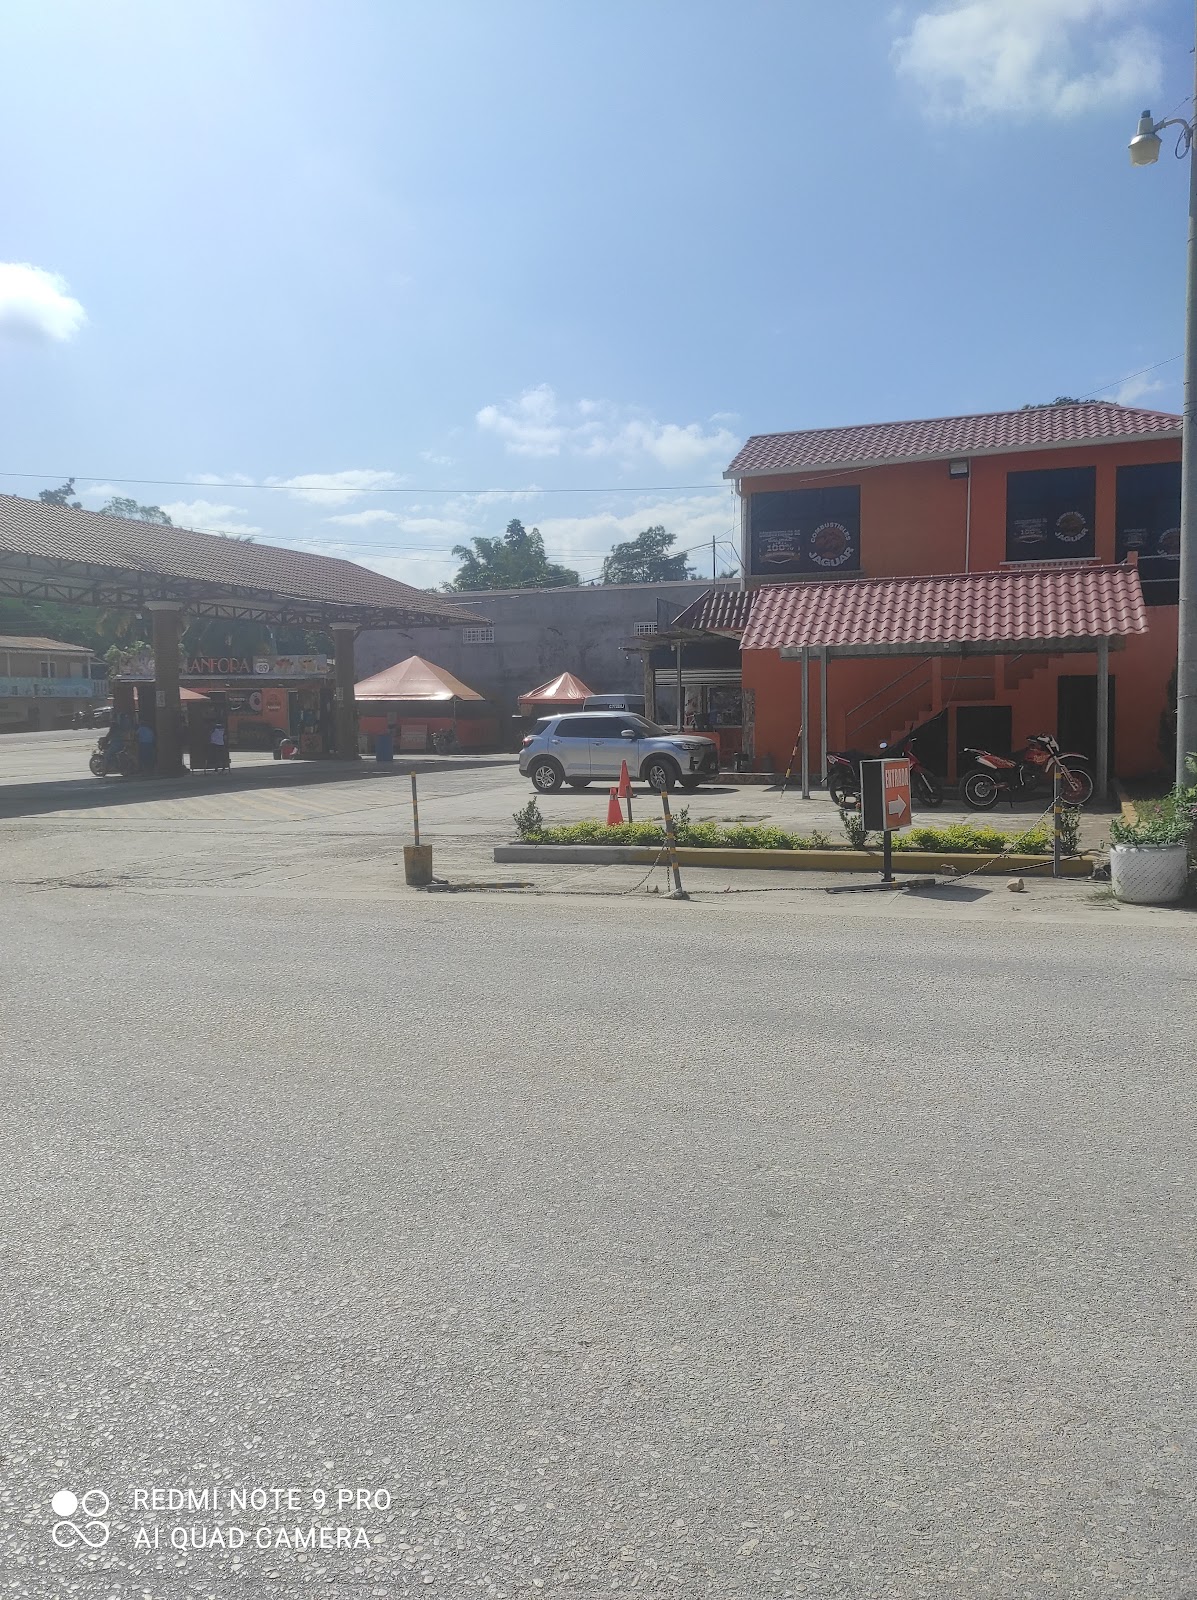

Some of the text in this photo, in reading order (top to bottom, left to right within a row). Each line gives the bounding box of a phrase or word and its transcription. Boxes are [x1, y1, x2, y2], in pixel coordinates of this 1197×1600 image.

[810, 522, 851, 543] COMBUSTIBLES
[808, 546, 855, 567] JAGUAR
[885, 768, 909, 788] ENTRADA
